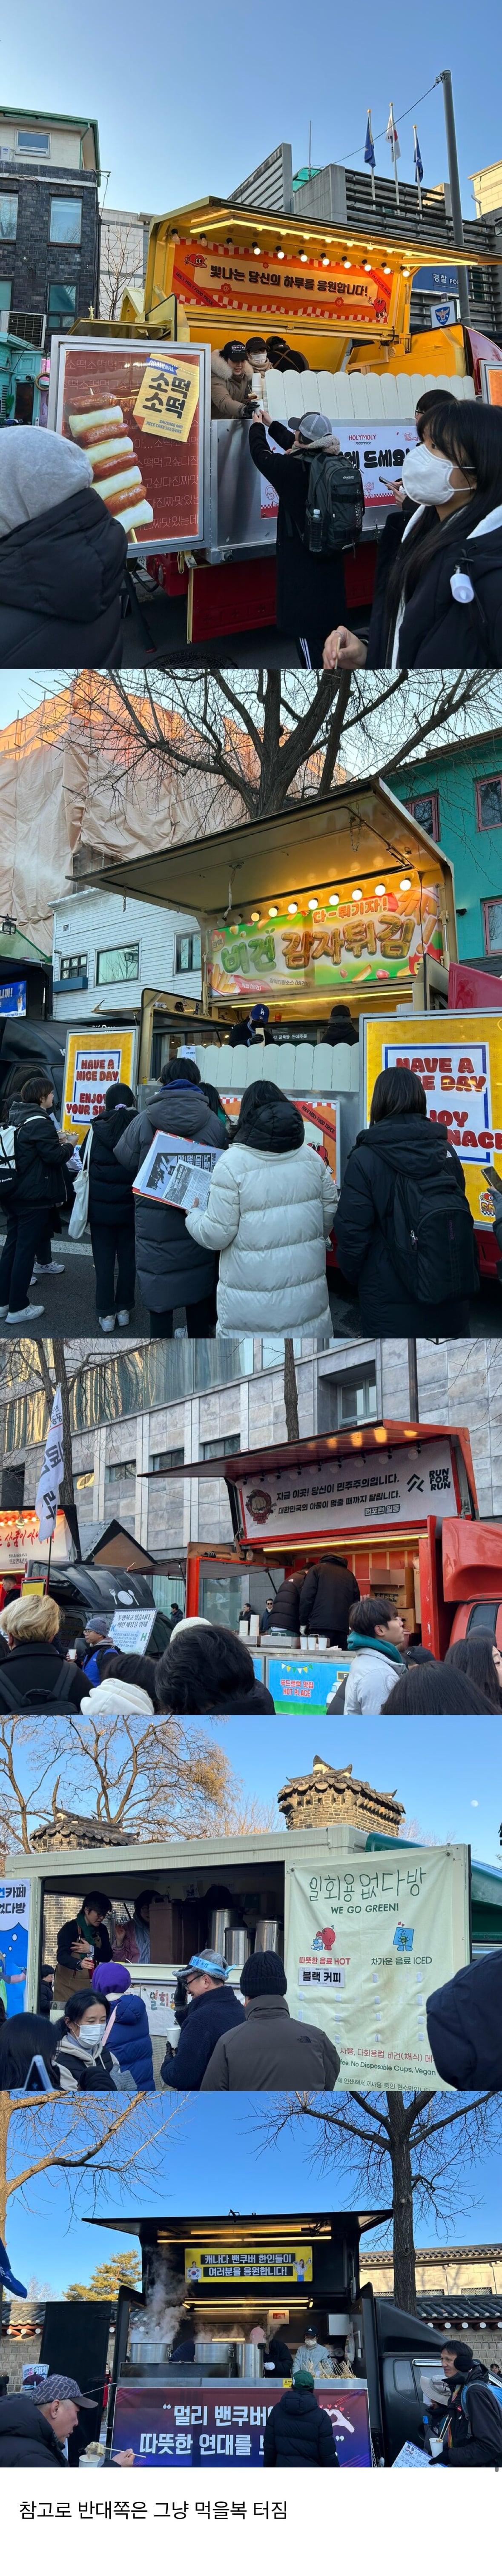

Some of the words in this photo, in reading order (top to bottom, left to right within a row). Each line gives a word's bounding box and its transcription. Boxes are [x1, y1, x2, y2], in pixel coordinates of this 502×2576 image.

[210, 265, 245, 281] 빛나는
[249, 270, 281, 286] 당신의
[284, 275, 314, 291] 하루를
[317, 280, 368, 297] 응원합니다!
[433, 274, 447, 284] 경찰
[175, 271, 185, 281] HOLY
[185, 279, 195, 289] MOLY
[194, 287, 204, 297] FOOD
[203, 294, 213, 305] TRUCK
[148, 372, 192, 400] 소떡
[142, 392, 186, 420] 소떡
[221, 935, 277, 974] 비건
[81, 1059, 106, 1070] HAVE
[107, 1059, 115, 1070] A
[396, 1057, 452, 1073] HAVE
[457, 1057, 475, 1074] A
[76, 1070, 98, 1081] NICE
[99, 1070, 119, 1081] DAY
[440, 1075, 486, 1092] DAY
[66, 1103, 90, 1115] YOUR
[301, 1105, 310, 1114] HOLY
[309, 1110, 317, 1120] MOLY
[316, 1116, 325, 1126] FOOD
[324, 1122, 336, 1135] TRUCK
[429, 1468, 449, 1478] RUN
[430, 1475, 449, 1484] FOR
[276, 1491, 290, 1501] 지금
[293, 1488, 309, 1499] 이곳!
[311, 1484, 335, 1496] 당신이
[337, 1473, 400, 1492] 민주주의입니다.
[430, 1481, 451, 1491] RUN
[278, 1504, 308, 1514] 대한민국의
[310, 1501, 329, 1510] 아픔이
[330, 1498, 344, 1508] 멈출
[346, 1495, 367, 1505] 때까지
[369, 1490, 401, 1502] 달립니다.
[365, 1506, 385, 1516] 런포런
[385, 1504, 400, 1514] 일동
[280, 1679, 301, 1688] 푸드트럭
[303, 1680, 314, 1689] 맛집
[294, 1689, 311, 1697] PLACE
[331, 1906, 344, 1914] WE
[347, 1905, 362, 1914] GO
[365, 1903, 399, 1913] GREEN!
[299, 1956, 318, 1964] 따뜻한
[319, 1957, 333, 1965] 음료
[371, 1957, 393, 1966] 차가운
[395, 1957, 411, 1965] 음료
[413, 1956, 432, 1965] ICED
[303, 1971, 321, 1982] 블랙
[324, 1972, 341, 1983] 커피
[340, 2047, 356, 2056] 사용,
[357, 2048, 386, 2059] 다회용컵,
[388, 2052, 423, 2062] 비건(채식)
[425, 2054, 435, 2063] 메
[360, 2061, 392, 2071] Disposable
[393, 2065, 413, 2074] Cups,
[415, 2067, 436, 2076] Vegan
[366, 2080, 382, 2089] 재사용
[204, 2255, 229, 2264] 캐나다
[232, 2254, 256, 2264] 밴쿠버
[258, 2253, 292, 2264] 한인들이
[208, 2267, 241, 2277] 여러분을
[244, 2266, 287, 2276] 응원합니다!
[214, 2406, 271, 2427] 밴쿠버
[139, 2433, 193, 2455] 따뜻한
[199, 2433, 252, 2456] 연대를
